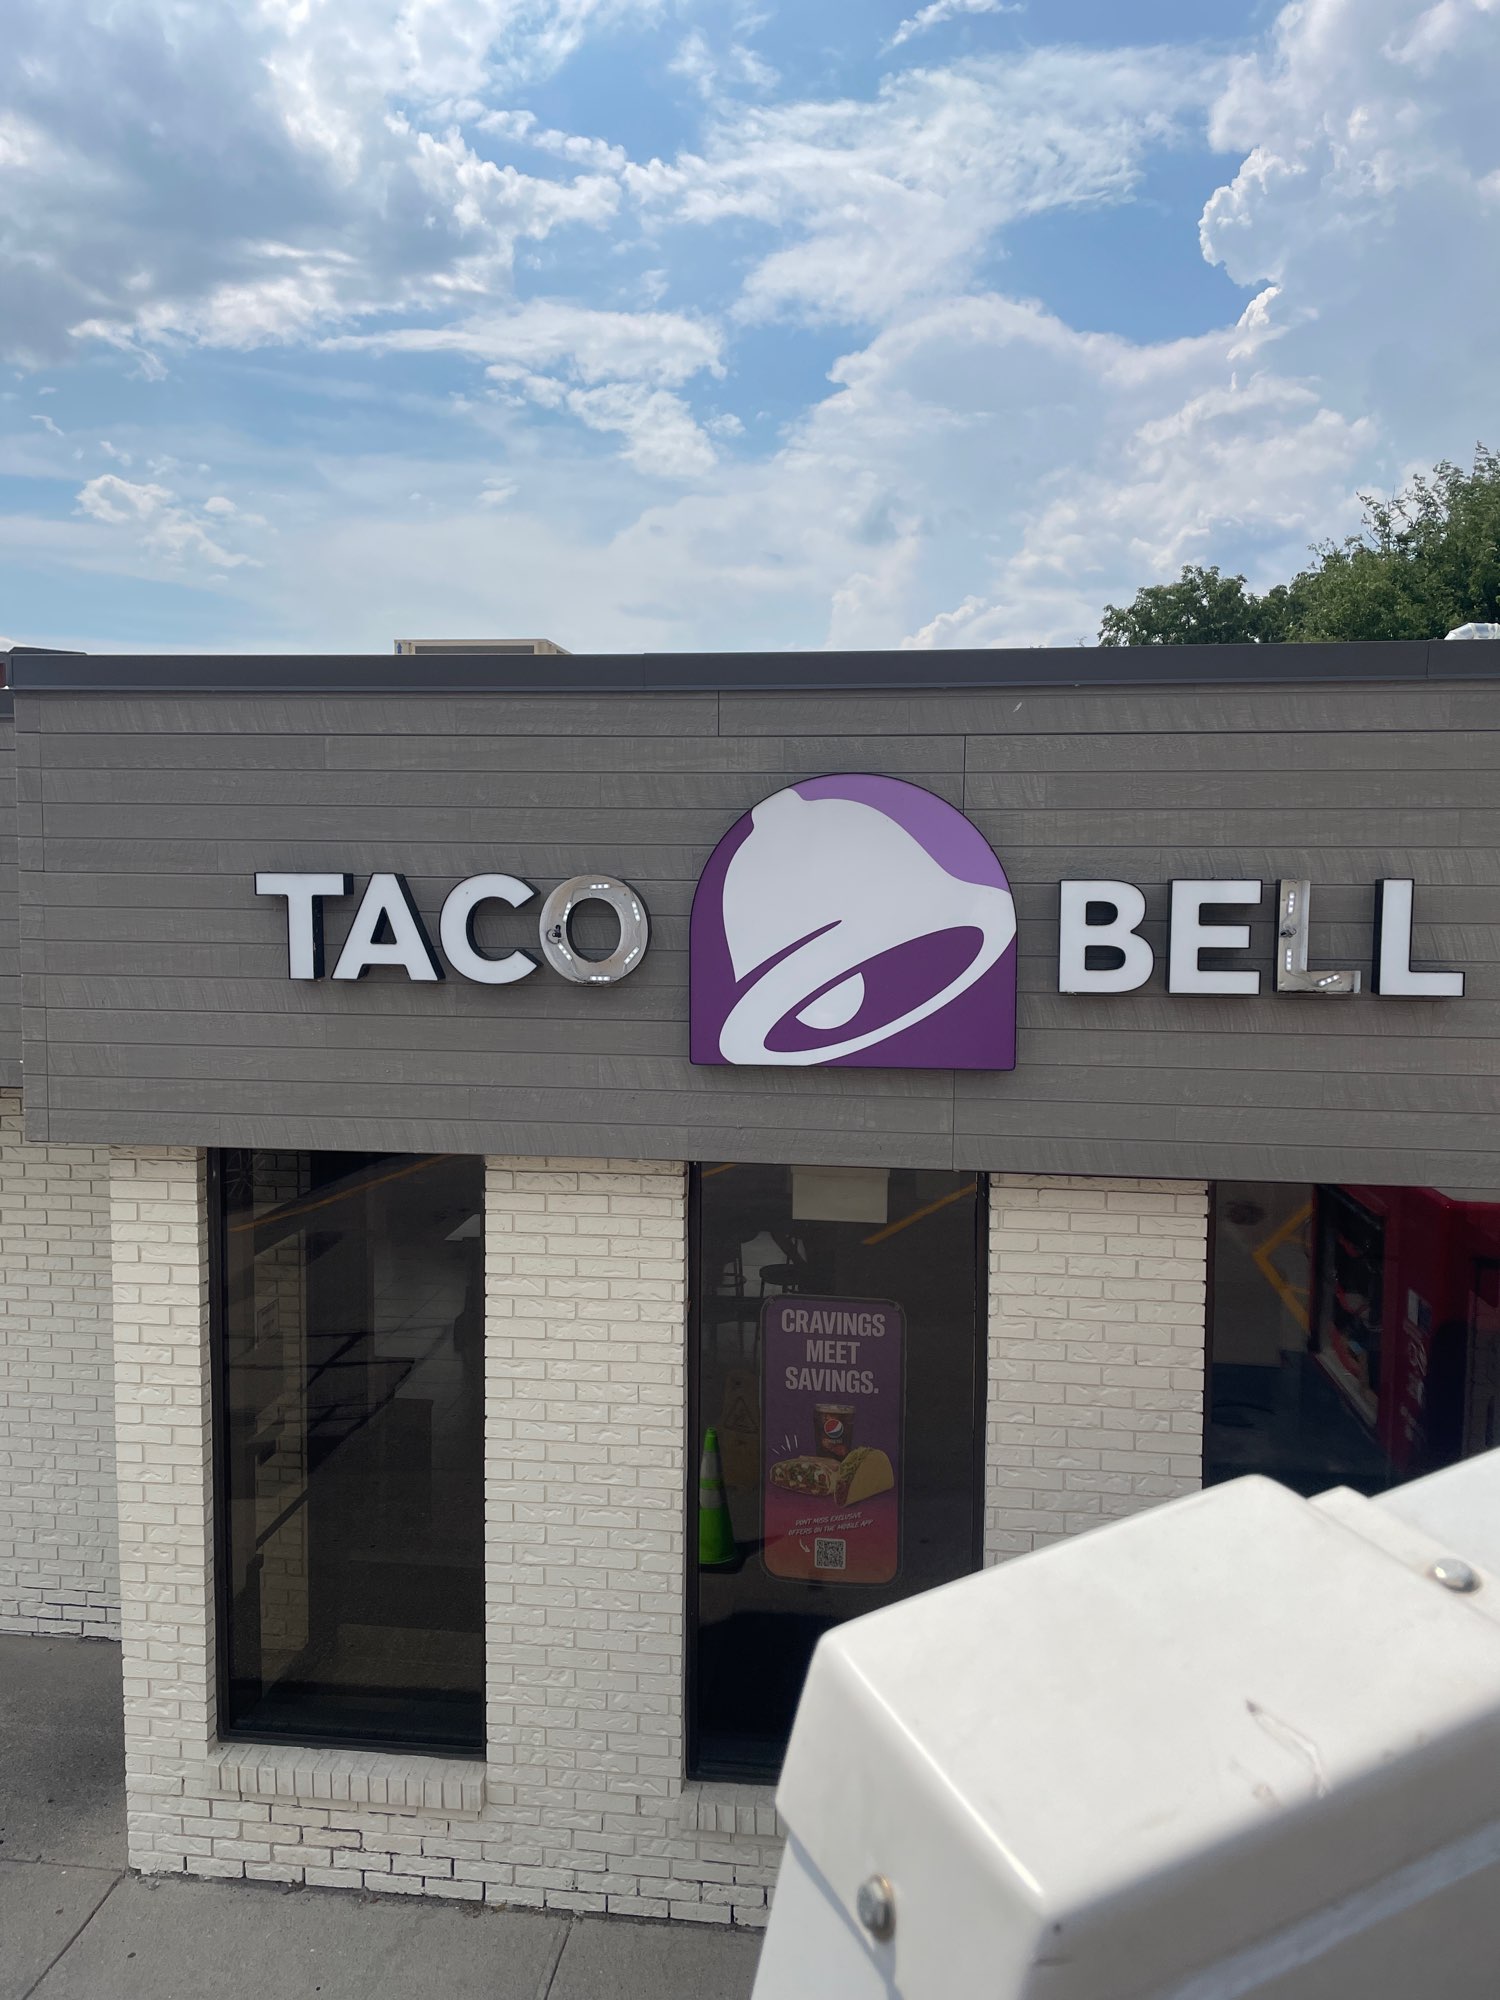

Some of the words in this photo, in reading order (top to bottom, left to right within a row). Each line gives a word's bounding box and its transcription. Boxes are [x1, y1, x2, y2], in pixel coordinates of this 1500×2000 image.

[254, 871, 651, 987] TACO
[1057, 878, 1465, 997] BELL
[781, 1308, 886, 1337] CRAVINGS
[806, 1339, 860, 1365] MEET
[785, 1366, 879, 1394] SAVINGS.
[830, 1511, 862, 1522] EXCLUSIVE
[788, 1527, 813, 1536] OFFERS
